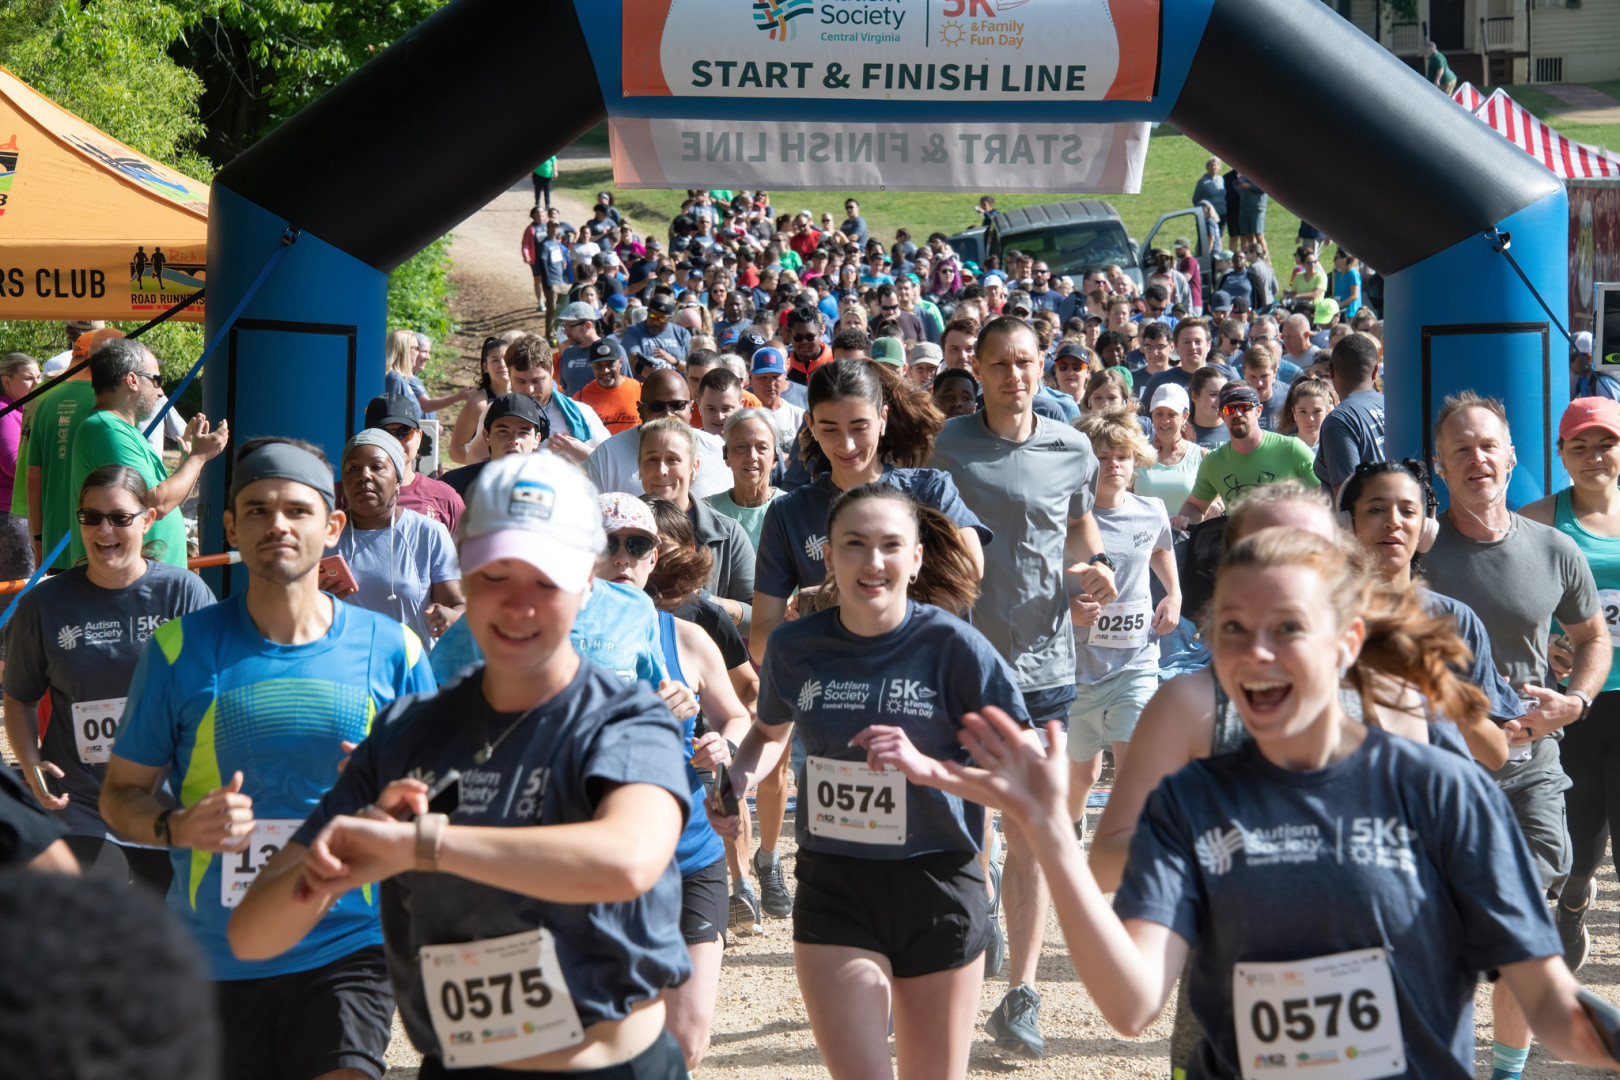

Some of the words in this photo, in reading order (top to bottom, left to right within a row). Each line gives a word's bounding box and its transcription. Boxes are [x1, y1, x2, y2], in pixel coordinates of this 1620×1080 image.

[820, 4, 905, 29] Society
[820, 32, 858, 42] Central
[860, 32, 900, 44] Virginia
[970, 35, 993, 46] Fun
[998, 35, 1024, 49] Day
[691, 60, 814, 88] START
[823, 62, 850, 89] &
[862, 63, 989, 91] FINISH
[1001, 65, 1086, 92] LINE
[36, 268, 105, 298] CLUB
[131, 294, 157, 304] ROAD
[84, 620, 121, 631] Autism
[137, 615, 161, 631] 5K
[1098, 613, 1145, 632] 0255
[84, 629, 123, 640] Society
[826, 680, 870, 691] Autism
[889, 679, 921, 700] 5K
[823, 689, 870, 703] Society
[822, 702, 843, 710] Central
[843, 702, 866, 711] Virginia
[903, 707, 917, 716] Fun
[918, 708, 934, 719] Day
[460, 768, 501, 786] tism
[817, 780, 896, 815] 0574
[1250, 823, 1320, 841] Autism
[1352, 816, 1398, 846] 5K
[440, 966, 553, 1022] 0575
[1250, 987, 1381, 1044] 0576
